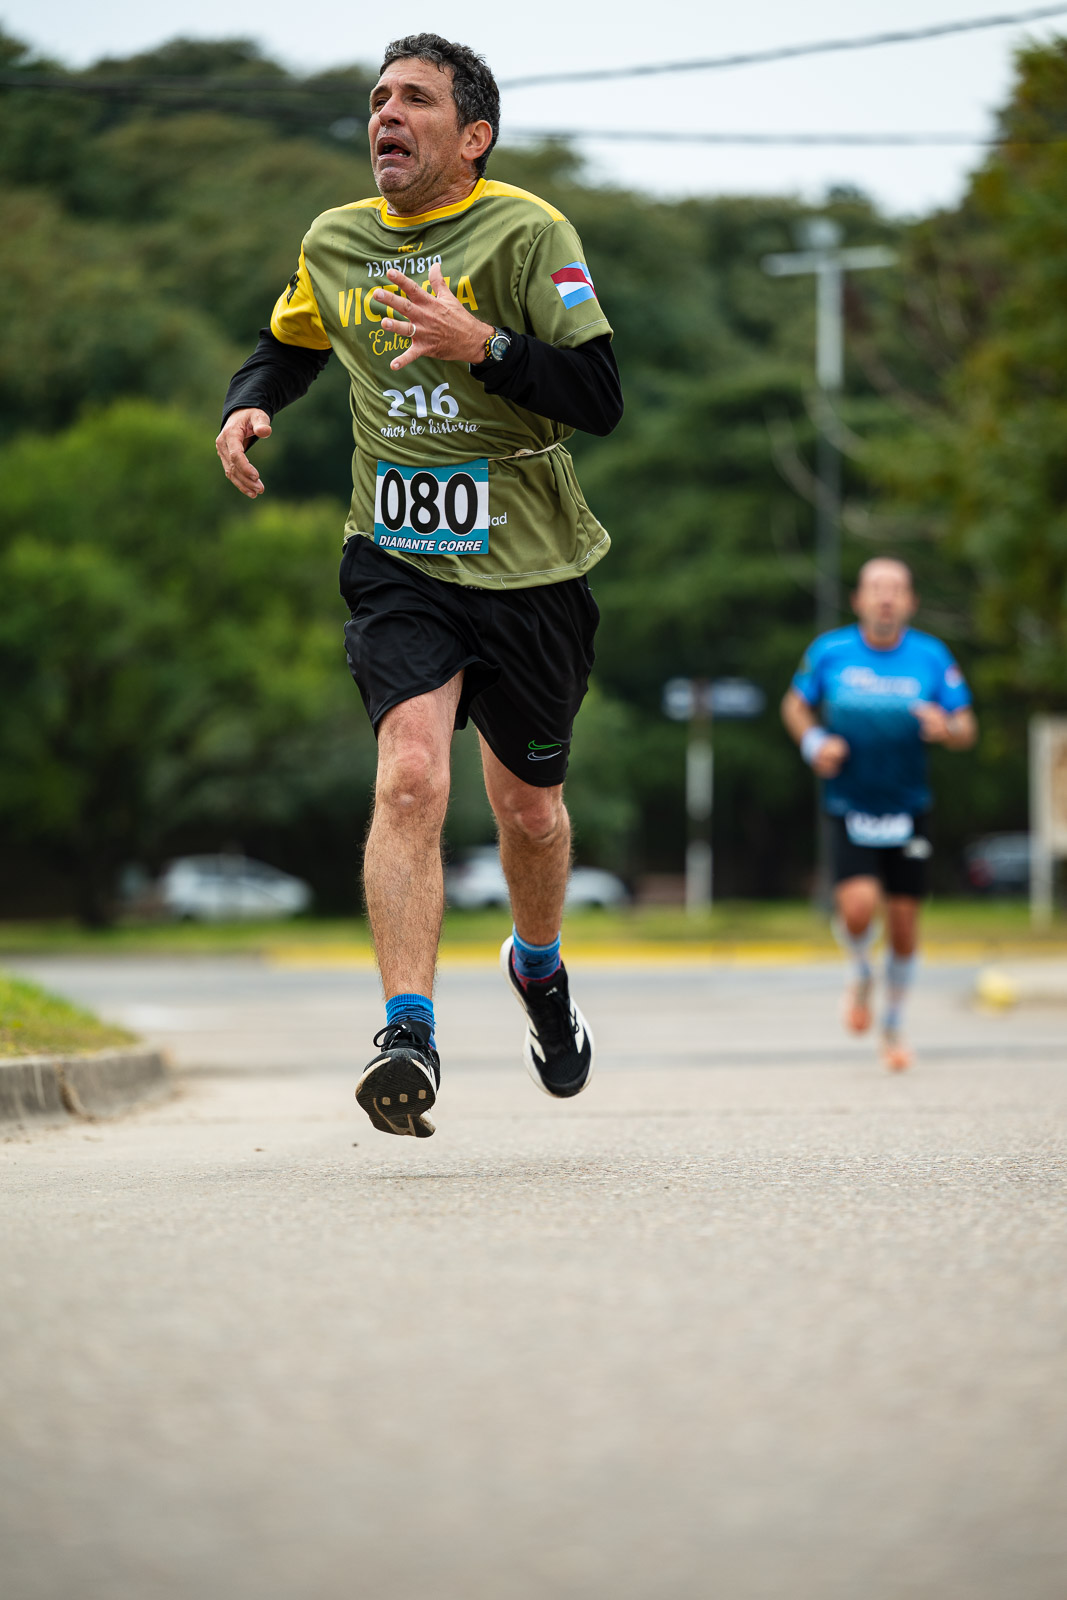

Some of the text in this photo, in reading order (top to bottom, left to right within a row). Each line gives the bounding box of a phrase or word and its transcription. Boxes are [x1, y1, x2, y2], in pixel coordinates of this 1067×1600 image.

[382, 382, 459, 418] 216
[380, 418, 480, 437] años de historia
[380, 468, 478, 536] 080
[379, 535, 483, 551] DIAMANTE CORRE
